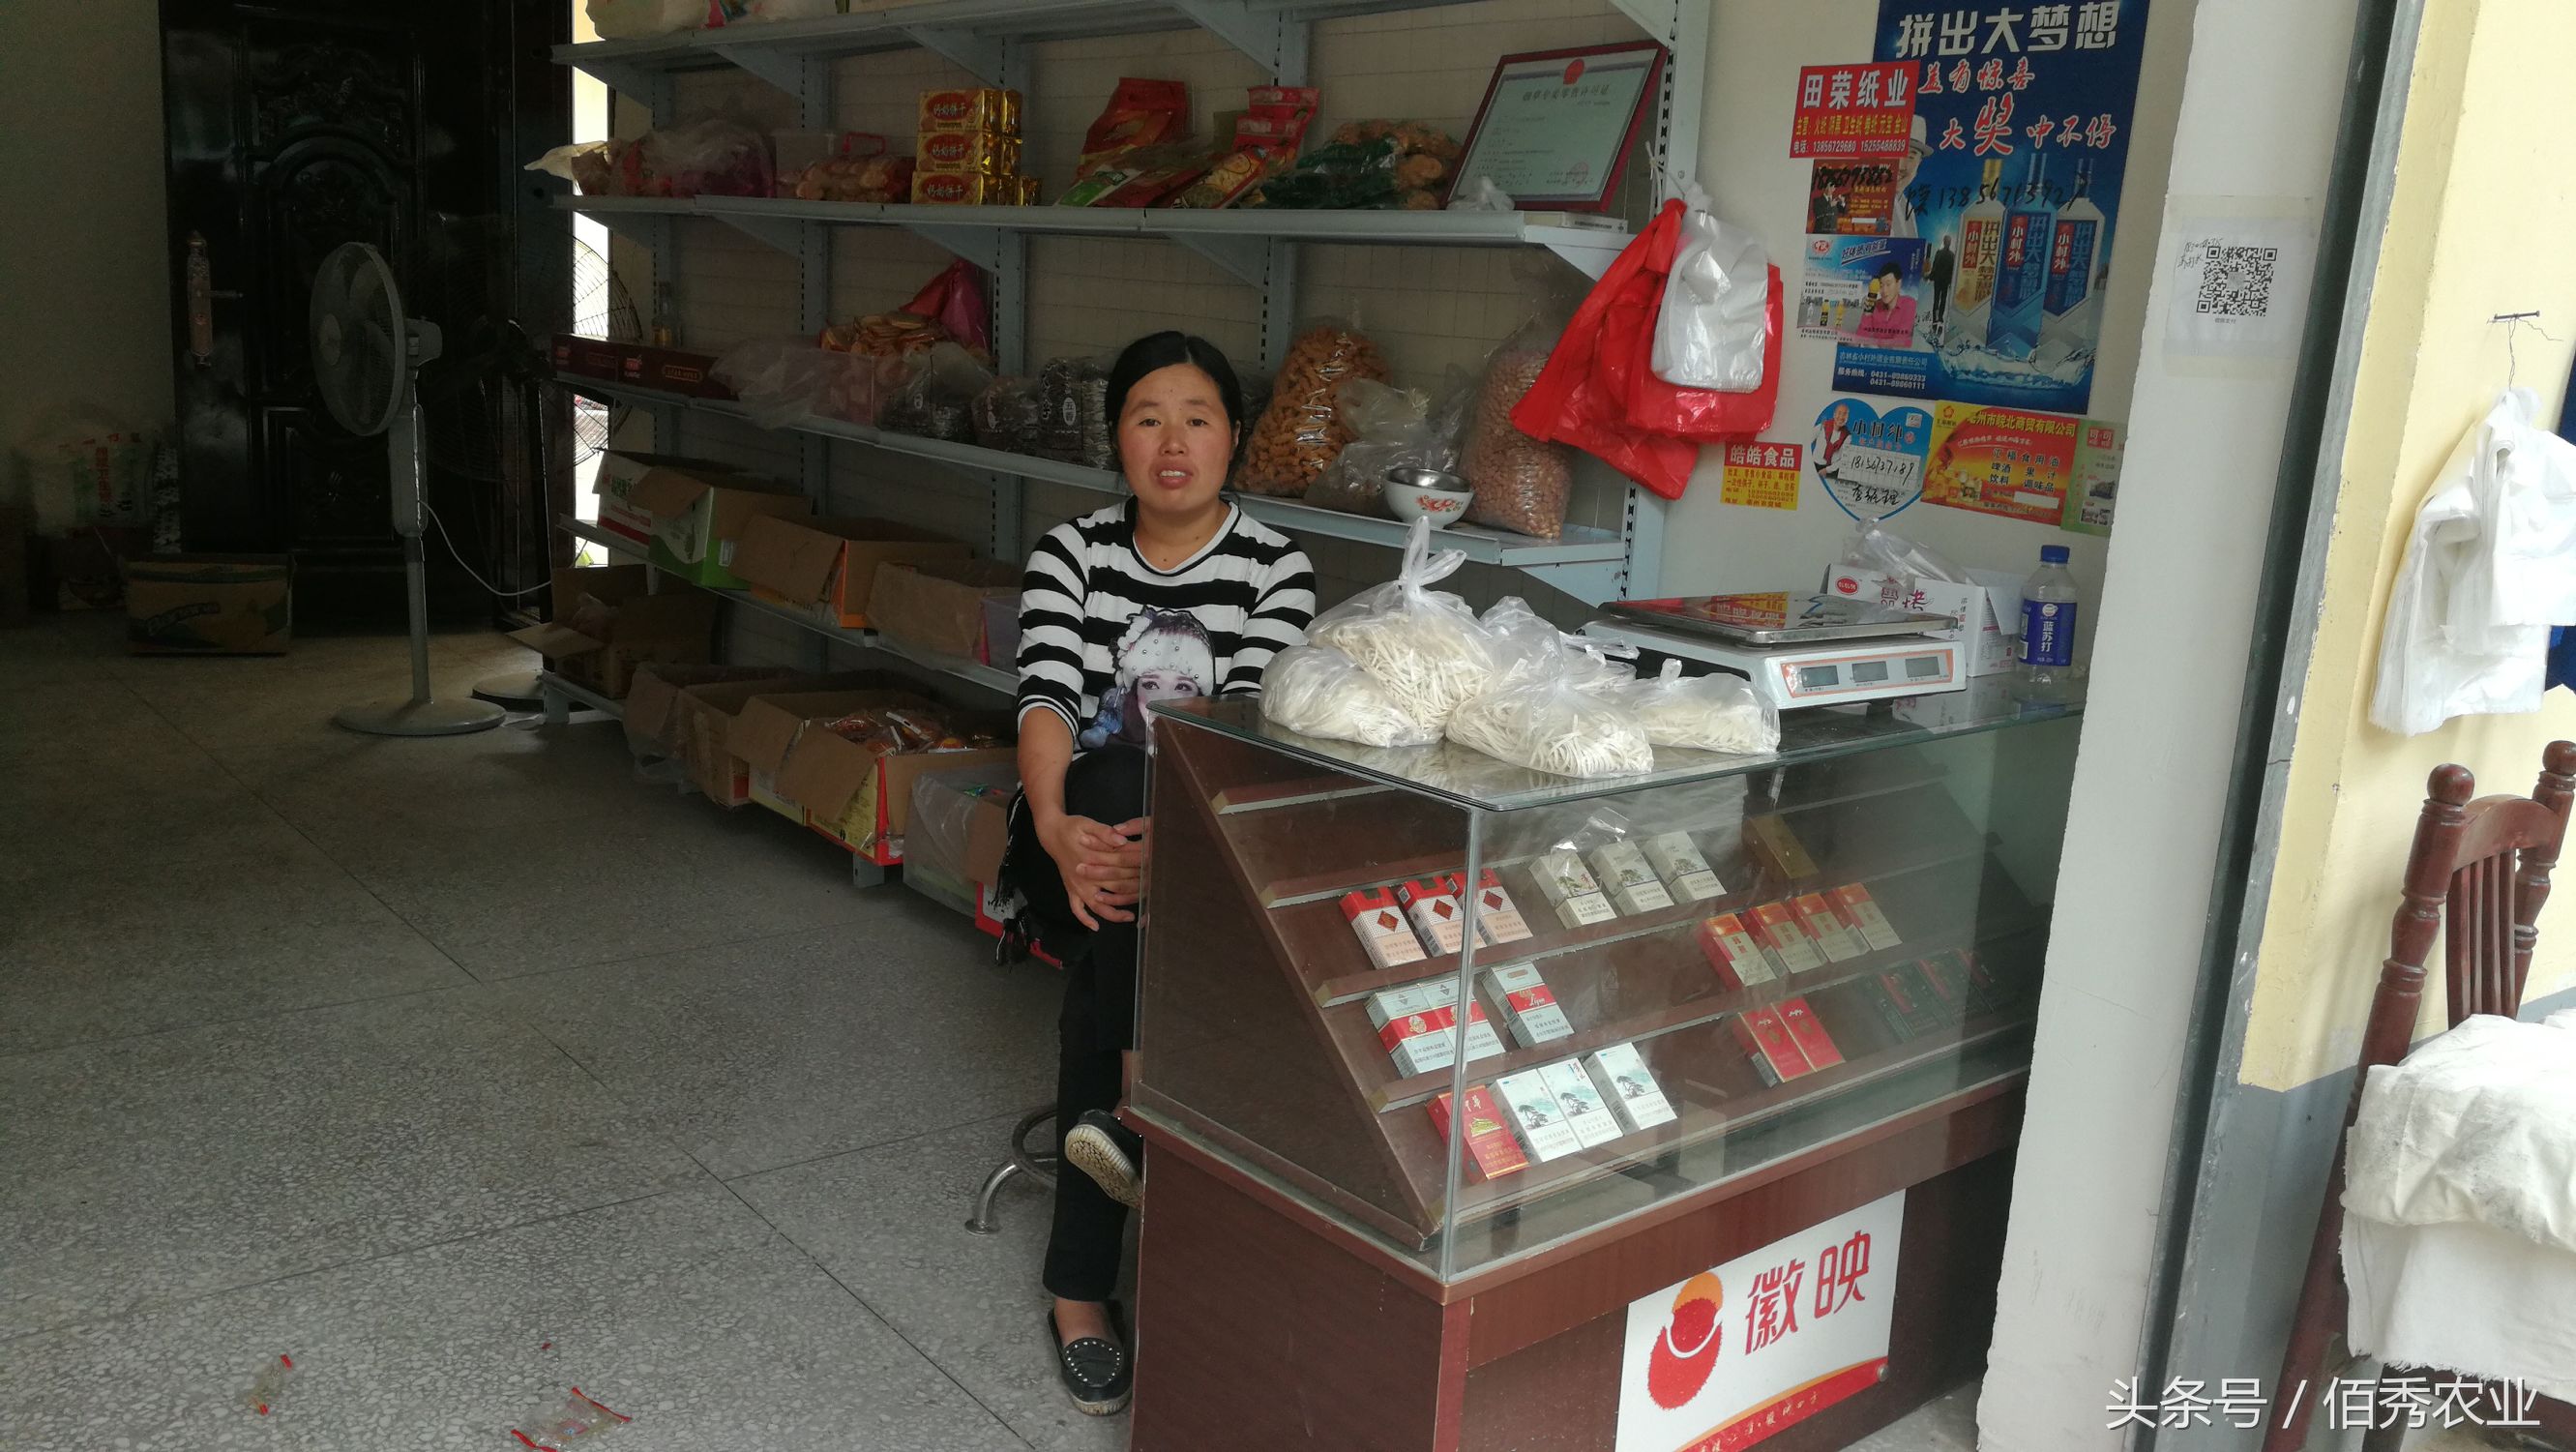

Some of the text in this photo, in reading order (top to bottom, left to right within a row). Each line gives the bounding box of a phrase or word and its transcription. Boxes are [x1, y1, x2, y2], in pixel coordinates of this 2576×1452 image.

[1896, 1, 2120, 58] 拼出大梦想
[1803, 69, 1909, 110] 田荣纸业
[1939, 92, 2117, 157] 大奖中不停
[1964, 230, 1980, 265] 小村外
[2006, 225, 2025, 262] 小村外
[2052, 233, 2071, 270] 小村外
[1731, 444, 1795, 467] 皓皓食品
[2040, 620, 2055, 653] 蓝苏打
[1744, 1230, 1871, 1356] 徽映
